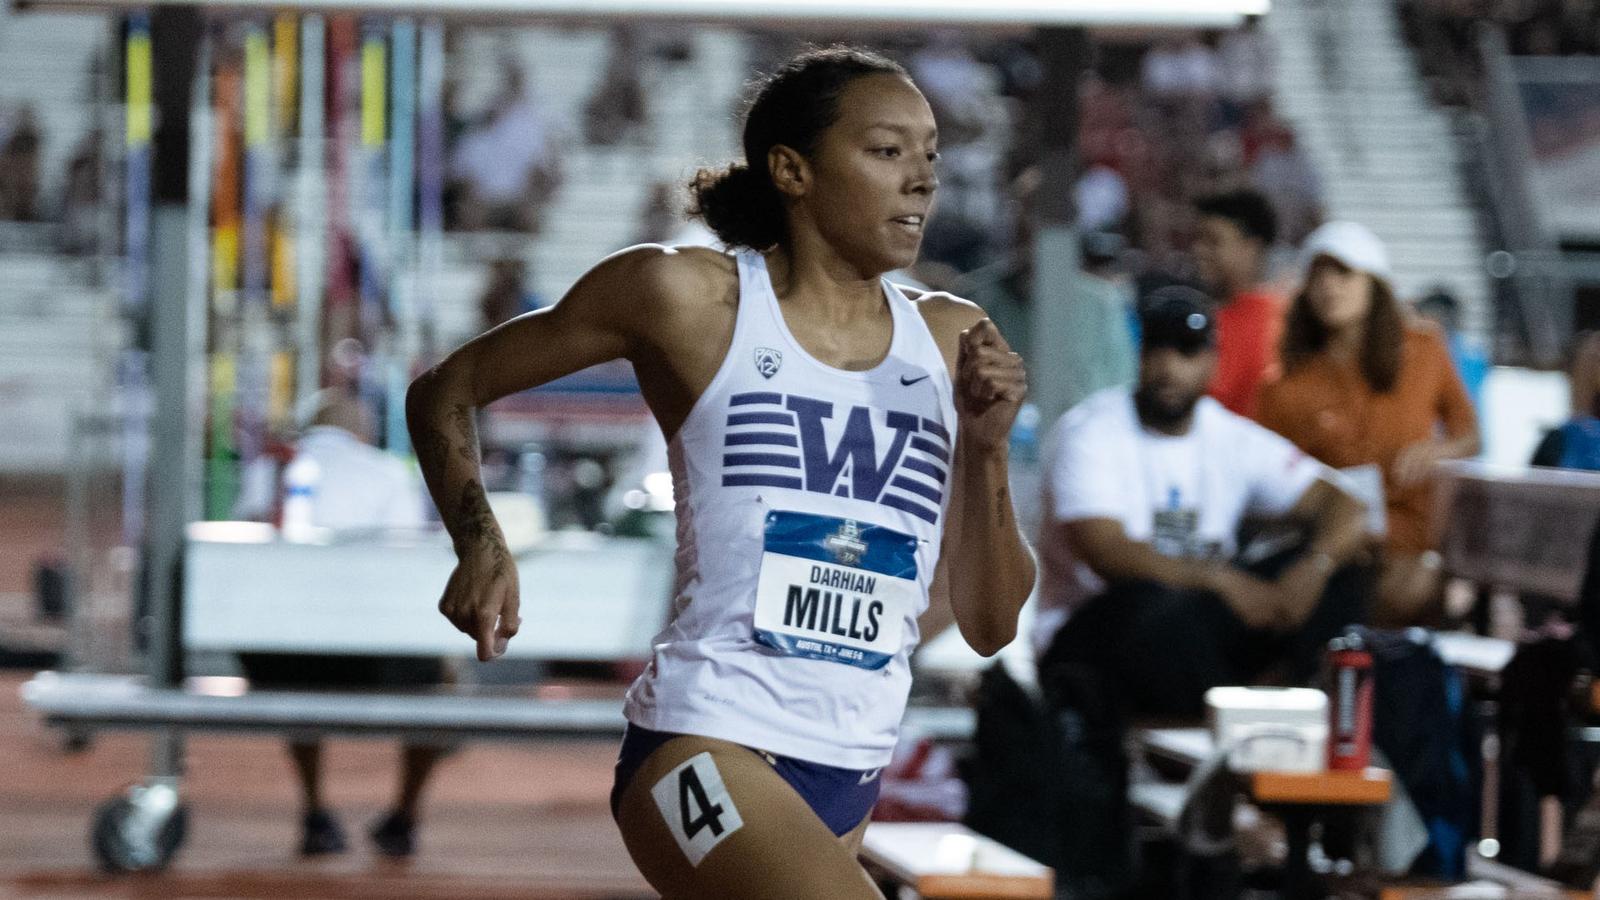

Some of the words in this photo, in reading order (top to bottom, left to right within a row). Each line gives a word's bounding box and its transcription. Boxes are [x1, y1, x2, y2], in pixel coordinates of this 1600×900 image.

[760, 361, 776, 374] 12
[786, 393, 919, 503] W
[809, 565, 876, 595] DARHIAN
[783, 584, 883, 642] MILLS
[678, 764, 725, 841] 4
